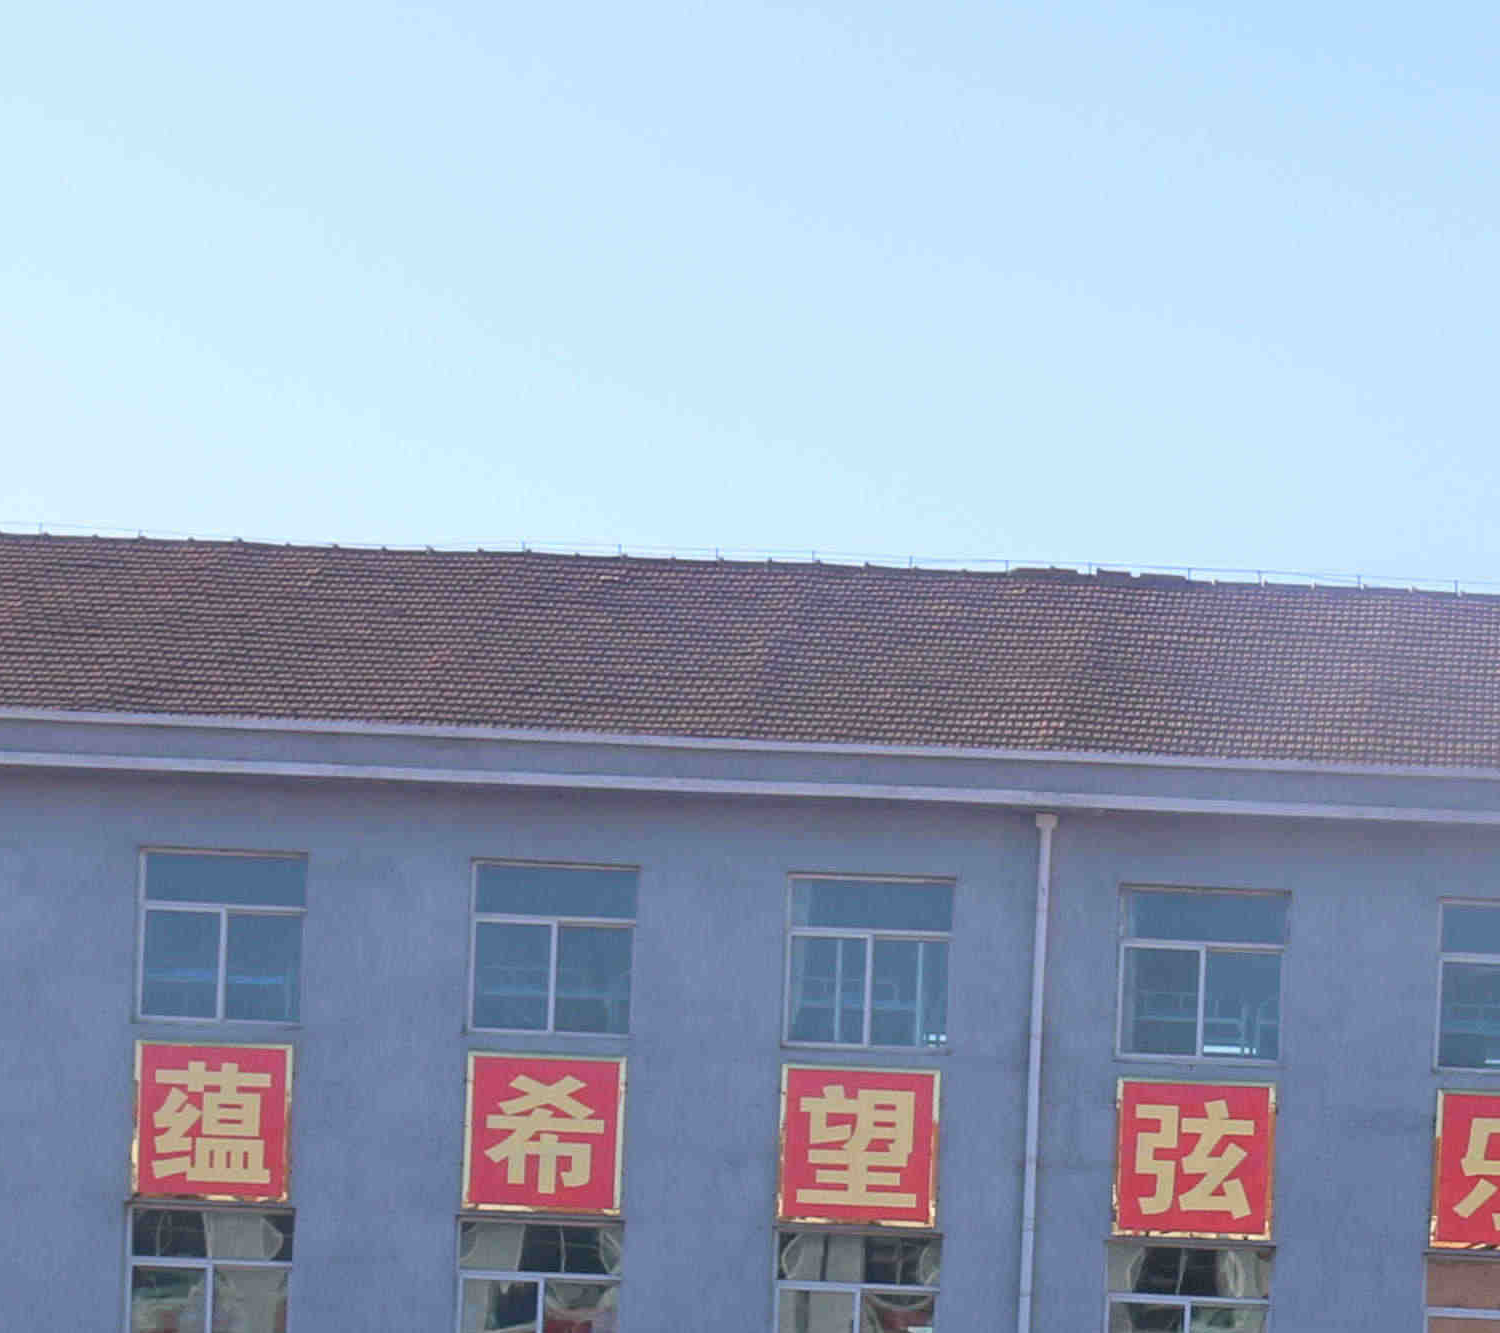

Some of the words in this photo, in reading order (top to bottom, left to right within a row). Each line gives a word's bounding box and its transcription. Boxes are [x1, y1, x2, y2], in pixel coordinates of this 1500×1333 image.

[156, 1064, 268, 1182] 蕴
[489, 1078, 604, 1193] 希
[798, 1086, 916, 1208] 望
[1136, 1099, 1254, 1216] 弦
